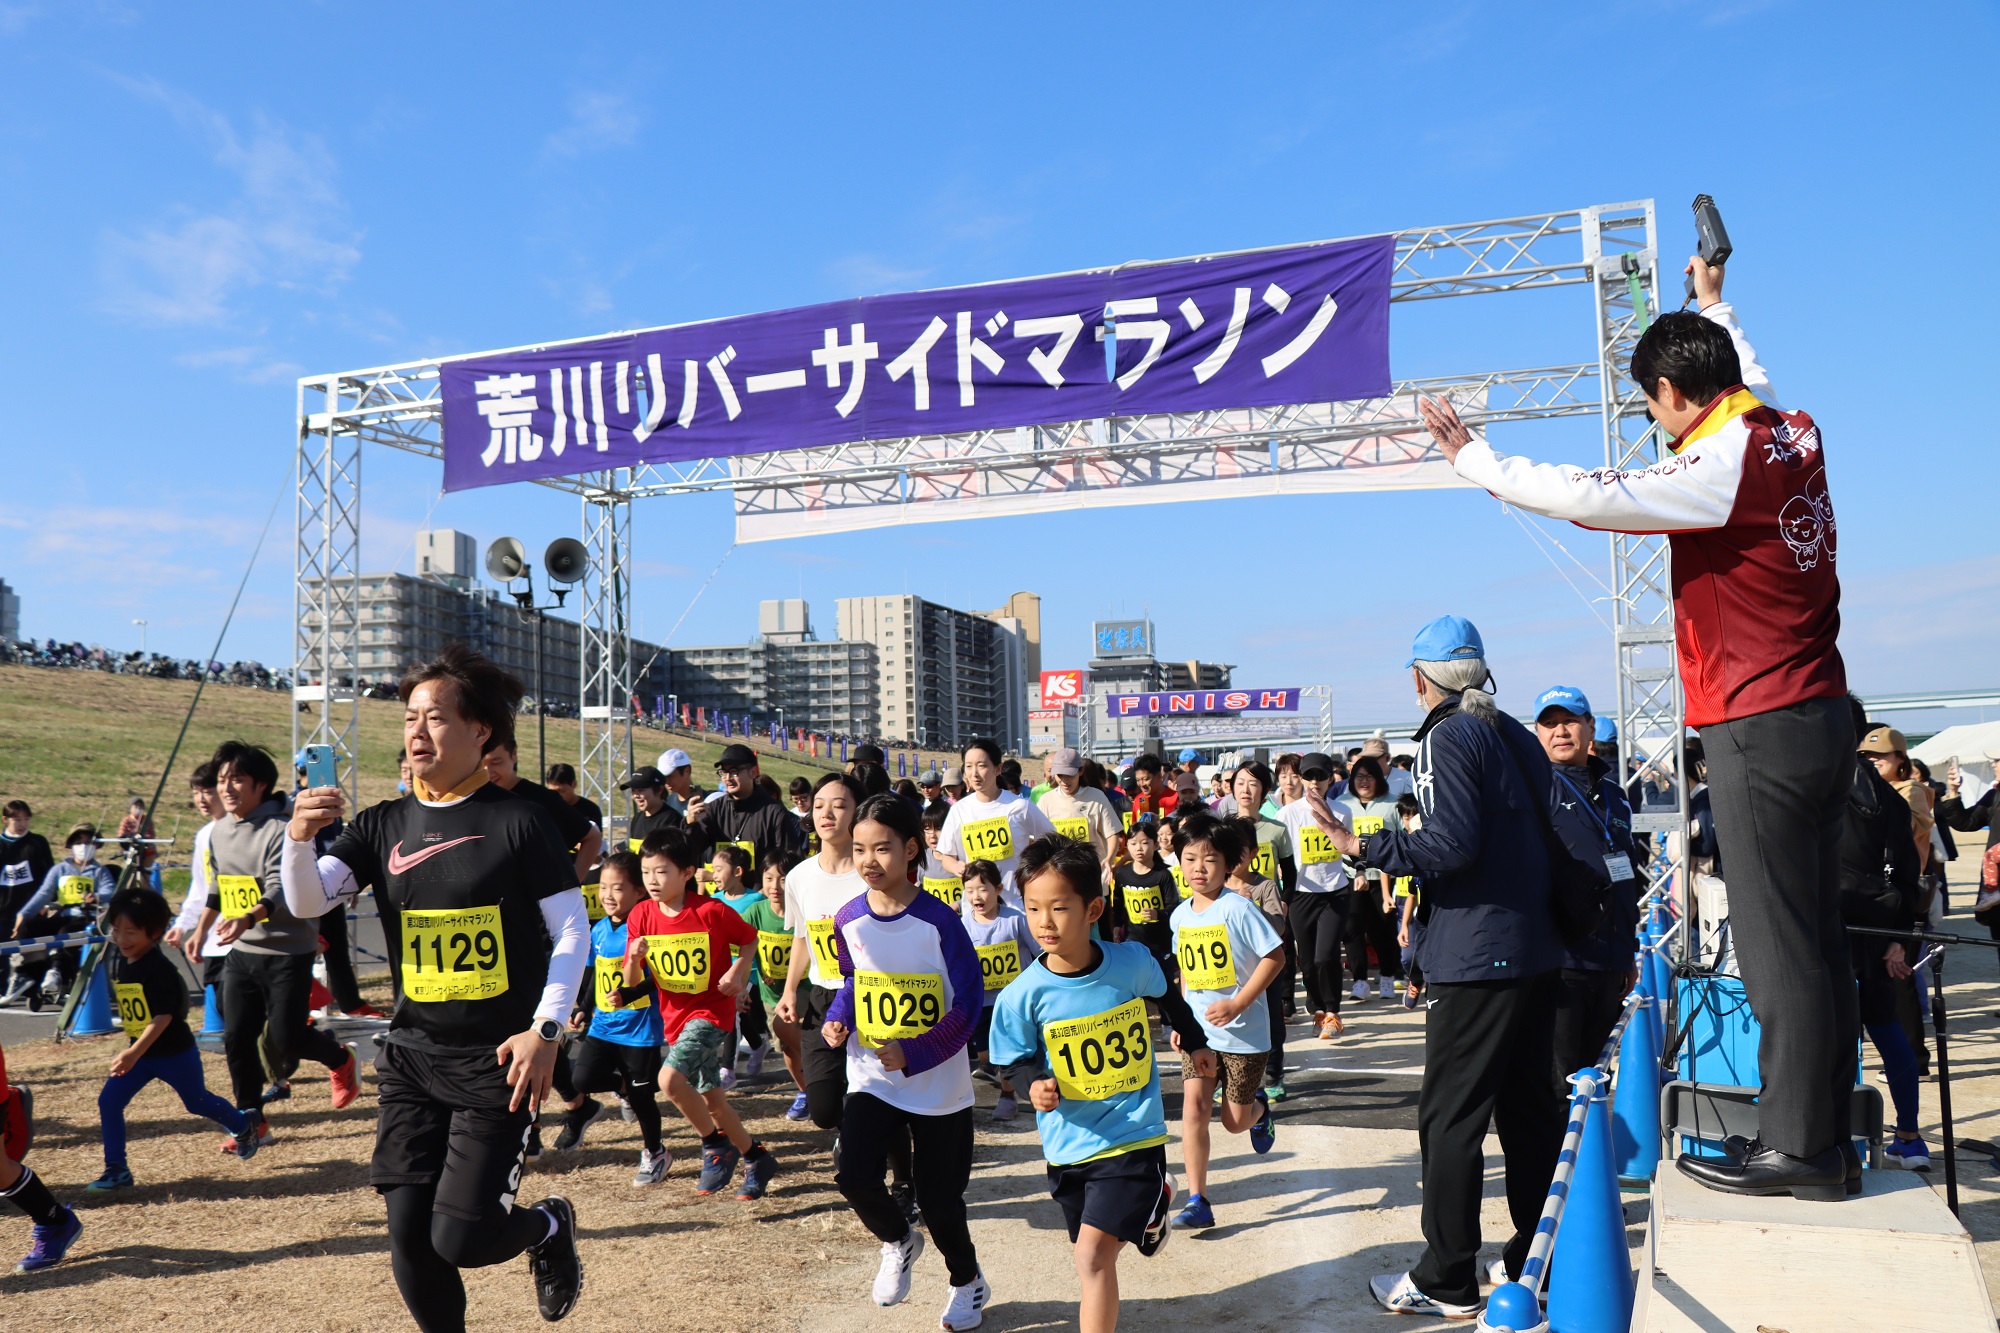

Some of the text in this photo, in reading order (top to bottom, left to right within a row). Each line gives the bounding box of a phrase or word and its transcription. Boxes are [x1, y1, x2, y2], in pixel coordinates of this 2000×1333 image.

[475, 282, 1338, 468] 荒川リバーサイドマラソン
[1119, 691, 1286, 714] FINISH
[1542, 690, 1572, 703] STAFF
[966, 826, 1009, 851] 1120
[1304, 835, 1339, 852] 112
[1250, 853, 1271, 873] 07
[224, 887, 259, 910] 1130
[927, 887, 962, 905] 016
[1127, 896, 1161, 914] 1009
[410, 929, 499, 974] 1129
[762, 943, 792, 966] 102
[815, 933, 840, 961] 10
[1180, 941, 1228, 971] 1019
[649, 947, 708, 976] 1003
[980, 952, 1019, 977] 002
[597, 970, 625, 995] 102
[118, 997, 147, 1021] 30
[862, 991, 940, 1028] 1029
[1050, 1005, 1141, 1040] 第32回荒川リバーサイドマラソン
[1058, 1021, 1148, 1078] 1033
[1084, 1074, 1141, 1095] クリナップ(株)
